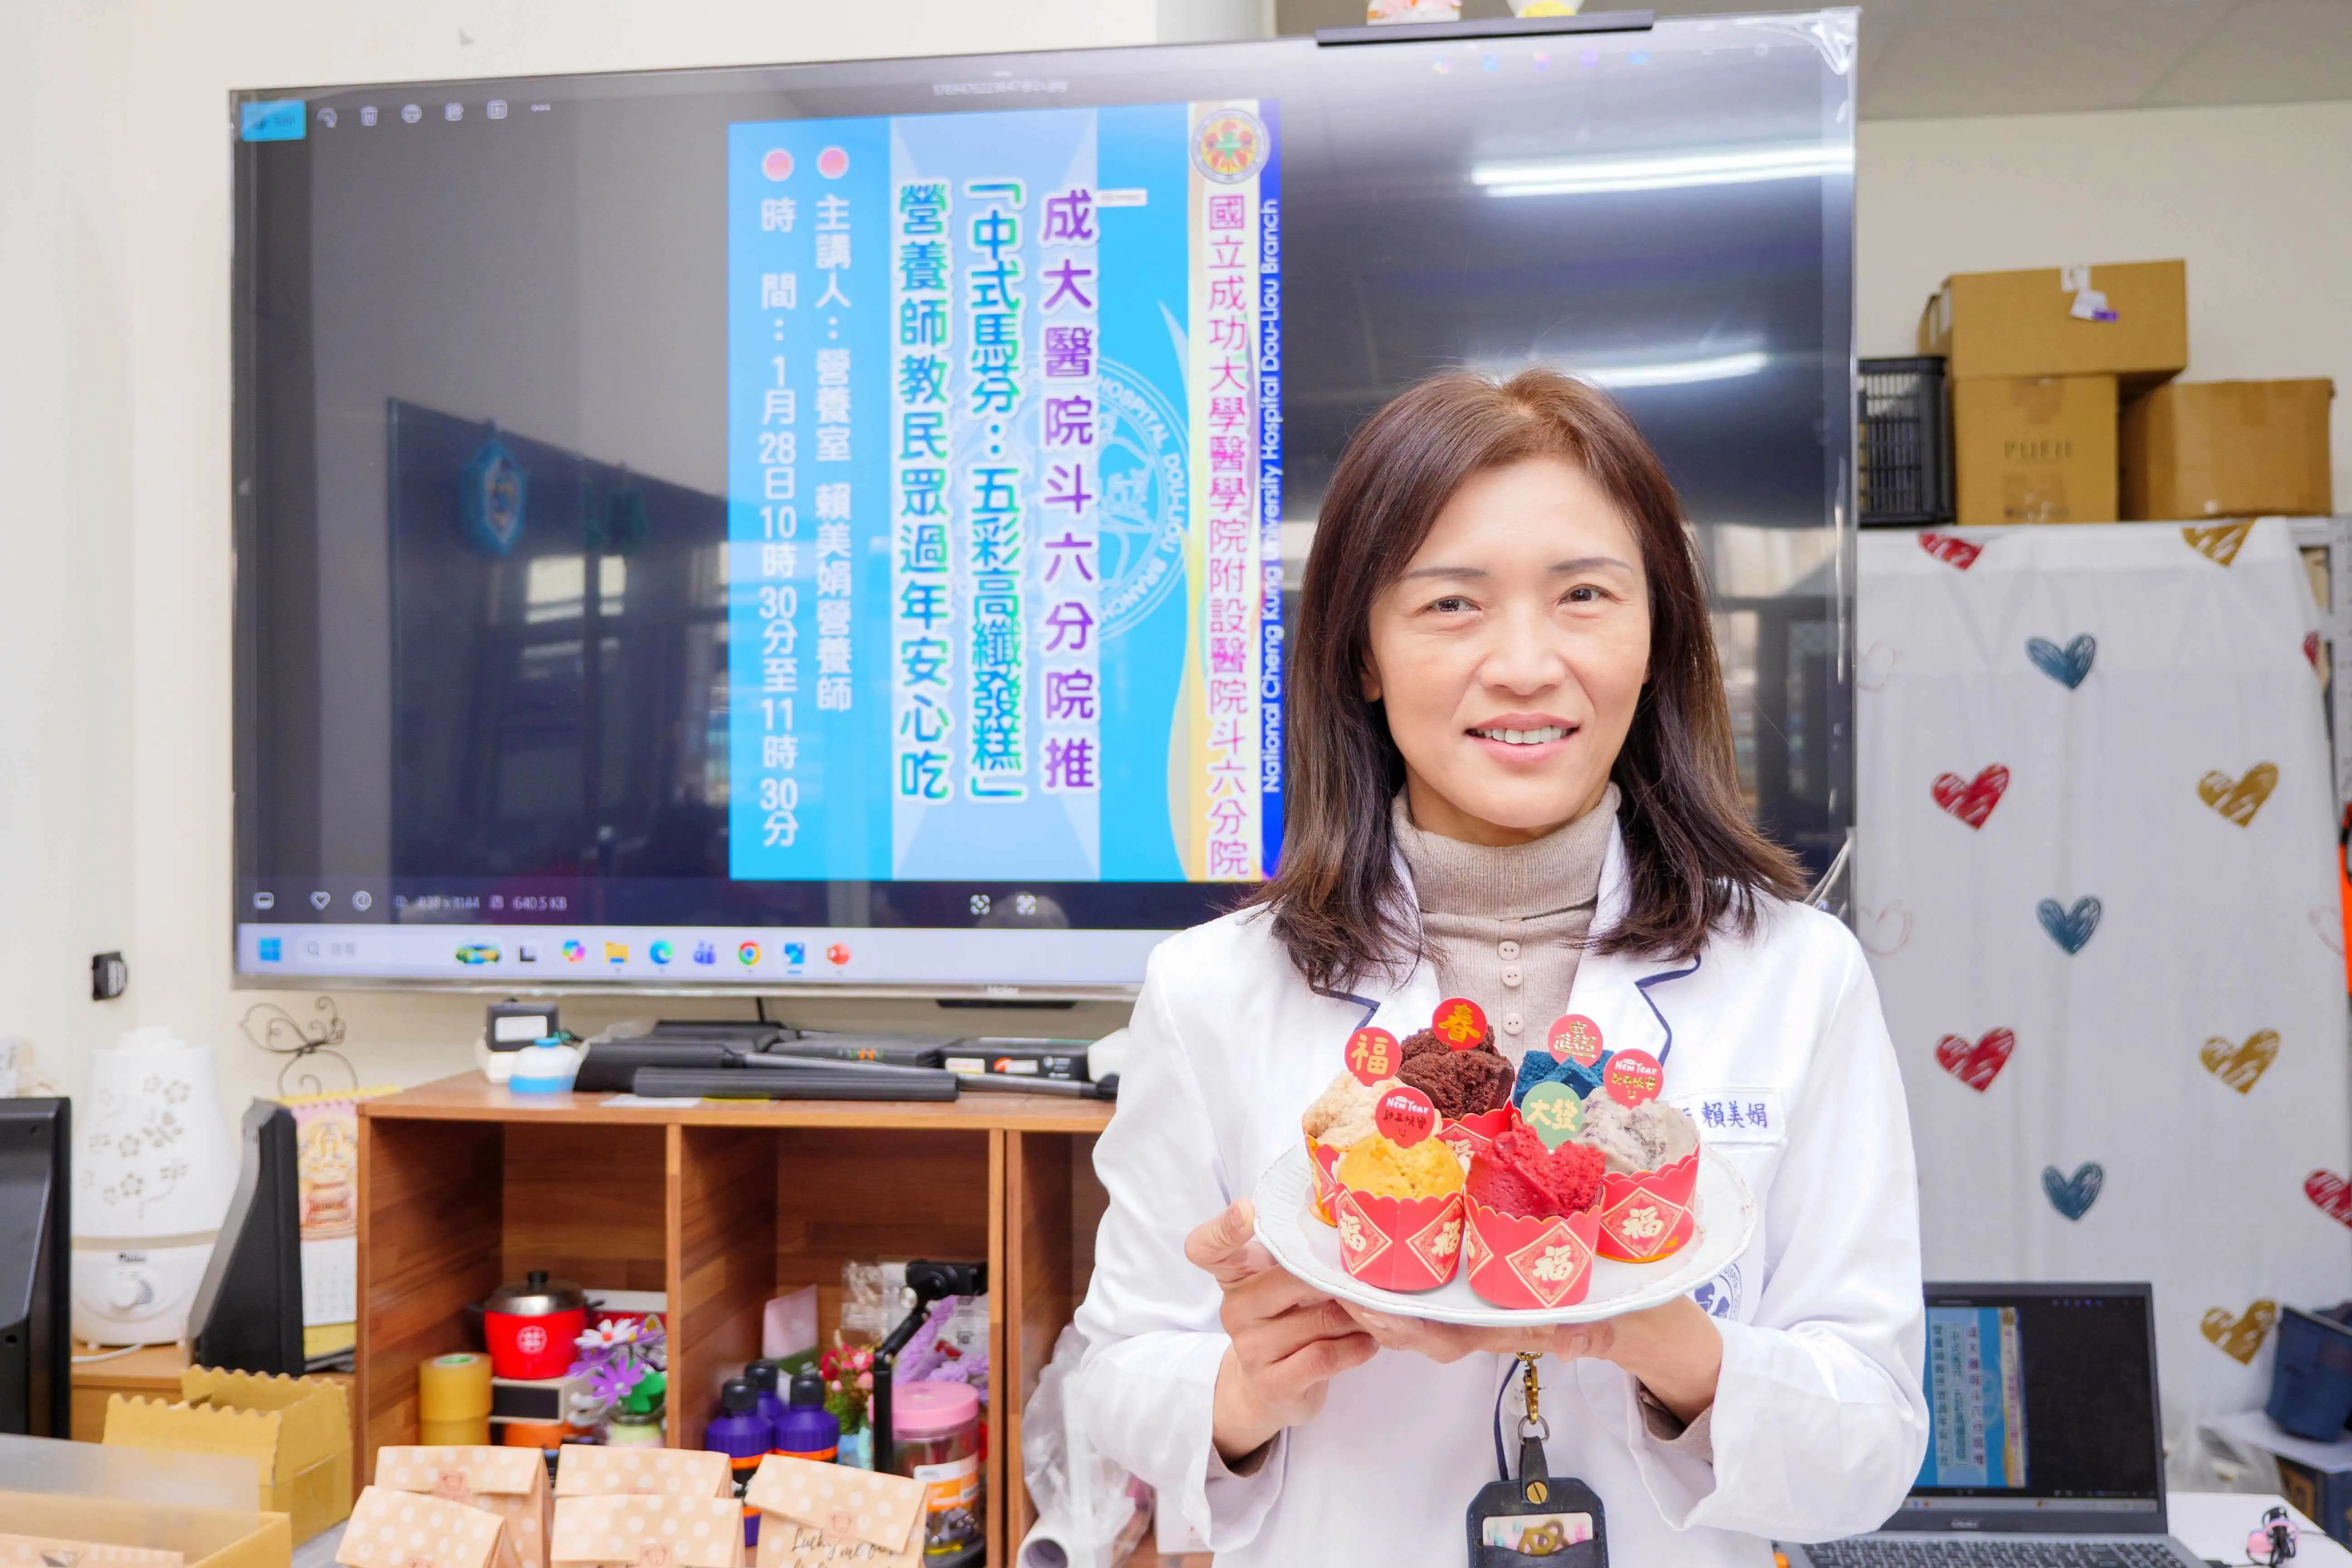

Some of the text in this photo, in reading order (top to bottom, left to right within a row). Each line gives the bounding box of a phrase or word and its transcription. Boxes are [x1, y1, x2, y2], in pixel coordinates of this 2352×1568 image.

[899, 183, 949, 799] 營養師教民眾過年安心吃
[1044, 189, 1094, 789] 成大醫院斗六分院推
[1259, 199, 1284, 793] National Cheng Kung University Hospital Dou-Liou Branch
[1208, 194, 1249, 876] 國立成功大學醫學院附設醫院斗六分院
[1438, 1004, 1481, 1043] 春
[1351, 1034, 1389, 1075] 福
[1614, 1060, 1635, 1071] New
[1636, 1062, 1657, 1075] Year
[1386, 1097, 1406, 1110] New
[1408, 1100, 1429, 1114] Year
[1527, 1099, 1578, 1132] 大發
[1701, 1101, 1768, 1128] 賴美娟
[1340, 1209, 1367, 1251] 福
[1431, 1218, 1460, 1257] 福
[1621, 1205, 1664, 1239] 福
[1532, 1245, 1573, 1281] 福
